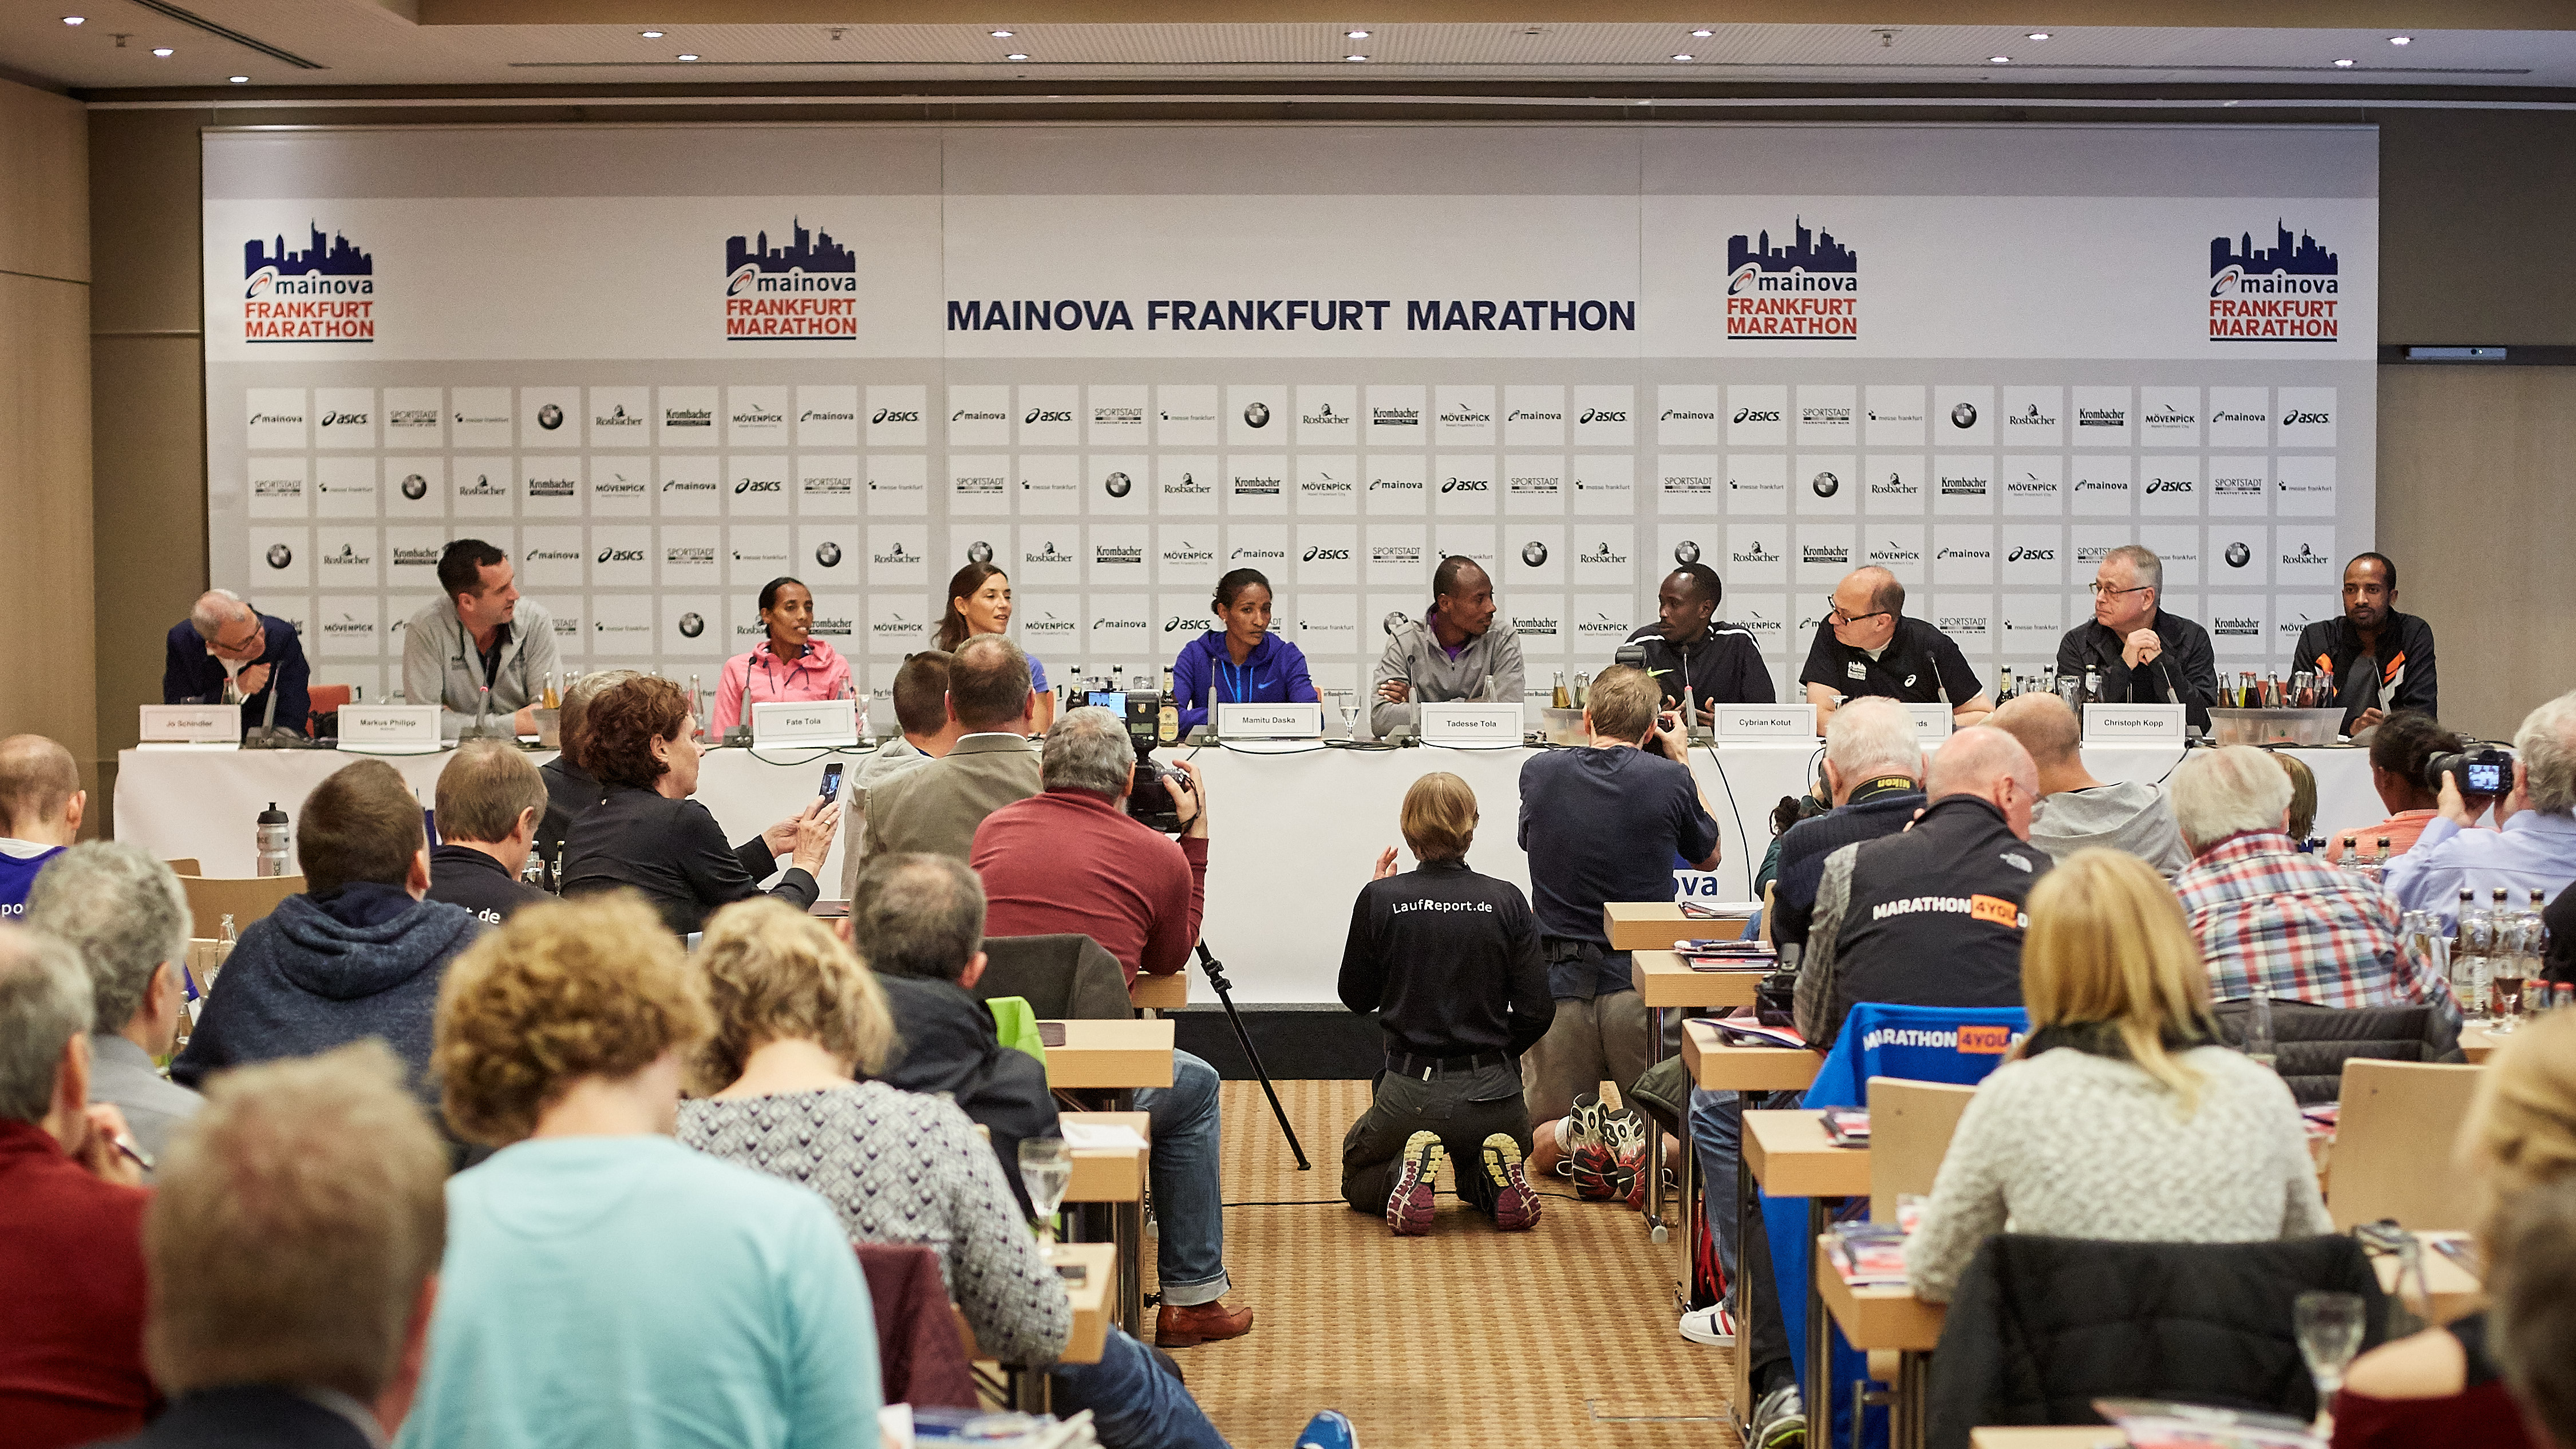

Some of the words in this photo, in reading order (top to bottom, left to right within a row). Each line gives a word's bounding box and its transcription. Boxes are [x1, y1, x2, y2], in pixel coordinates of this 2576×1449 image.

[276, 276, 373, 294] mainova
[757, 273, 856, 291] mainova
[1759, 272, 1857, 291] mainova
[2241, 274, 2338, 293] mainova
[245, 301, 373, 318] FRANKFURT
[726, 298, 856, 315] FRANKFURT
[1727, 298, 1856, 315] FRANKFURT
[2210, 300, 2337, 317] FRANKFURT
[947, 300, 1134, 331] MAINOVA
[1148, 300, 1390, 331] FRANKFURT
[1407, 300, 1635, 331] MARATHON
[245, 321, 373, 337] MARATHON
[726, 318, 856, 334] MARATHON
[1727, 317, 1856, 334] MARATHON
[2210, 319, 2337, 336] MARATHON
[965, 411, 1005, 420] mainova
[1374, 408, 1419, 418] Krombacher
[1520, 411, 1560, 420] mainova
[1673, 411, 1713, 420] mainova
[2080, 408, 2124, 418] Krombacher
[2225, 413, 2265, 421] mainova
[1303, 414, 1349, 424] Rosbacher
[2010, 415, 2056, 424] Rosbacher
[1235, 477, 1280, 487] Krombacher
[1382, 480, 1422, 489] mainova
[1942, 477, 1986, 487] Krombacher
[2087, 481, 2127, 489] mainova
[1165, 484, 1211, 493] Rosbacher
[1872, 484, 1918, 493] Rosbacher
[1097, 546, 1141, 555] Krombacher
[1243, 549, 1283, 558] mainova
[1803, 545, 1848, 555] Krombacher
[1949, 549, 1989, 558] mainova
[2077, 547, 2111, 555] SPORTST
[1026, 552, 1072, 562] Rosbacher
[1581, 553, 1626, 562] Rosbacher
[1733, 552, 1779, 561] Rosbacher
[2282, 554, 2328, 563] Rosbacher
[811, 618, 853, 628] rombacher
[1106, 619, 1146, 628] mainova
[1512, 617, 1557, 627] Krombacher
[2215, 618, 2259, 627] Krombacher
[389, 719, 416, 728] Philipp
[1739, 718, 1768, 728] Cybrian
[2104, 719, 2141, 728] Christoph
[2143, 719, 2164, 728] Kopp
[1878, 779, 1910, 789] Nikon
[1393, 899, 1492, 914] LaufReport.de
